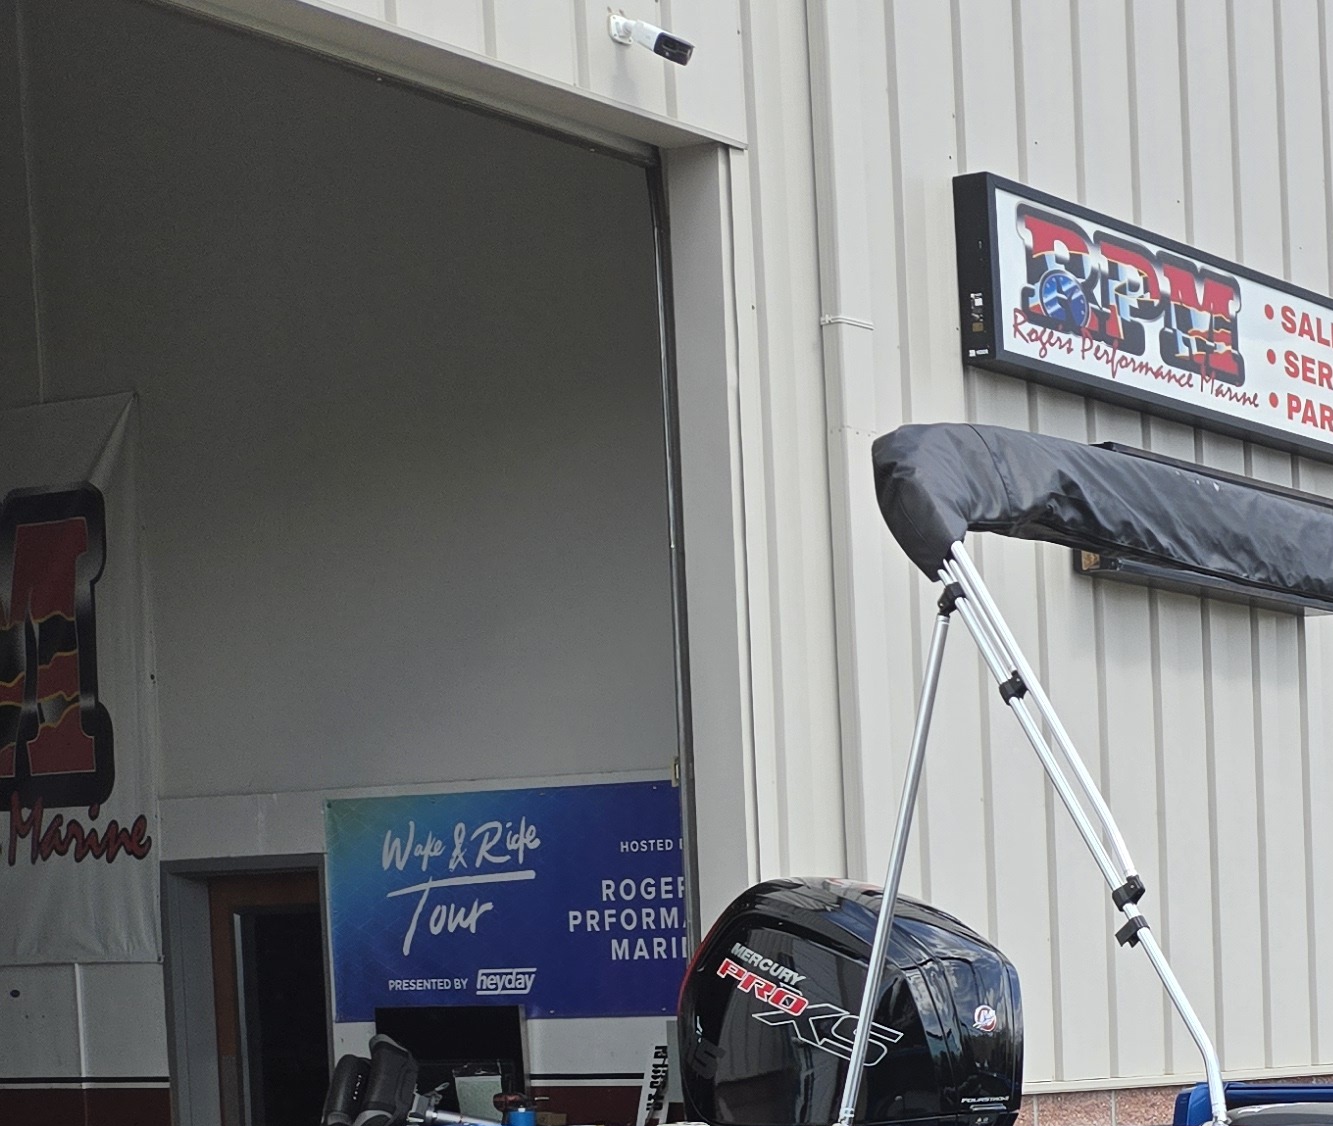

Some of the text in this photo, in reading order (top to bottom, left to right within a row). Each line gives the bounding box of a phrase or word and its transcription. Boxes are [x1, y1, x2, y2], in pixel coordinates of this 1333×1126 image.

[1016, 202, 1245, 386] RPM
[1080, 327, 1194, 388] Performance
[1199, 362, 1260, 408] Marine
[8, 790, 152, 867] Marine
[382, 816, 541, 872] Wake & Ride
[620, 839, 674, 853] HOSTED
[386, 870, 537, 957] Tour
[568, 906, 687, 932] PRFORM
[388, 968, 537, 996] PRESENTED BY heyday
[717, 958, 809, 1017] PRO
[730, 942, 807, 986] MERCURY
[752, 1003, 904, 1067] XS
